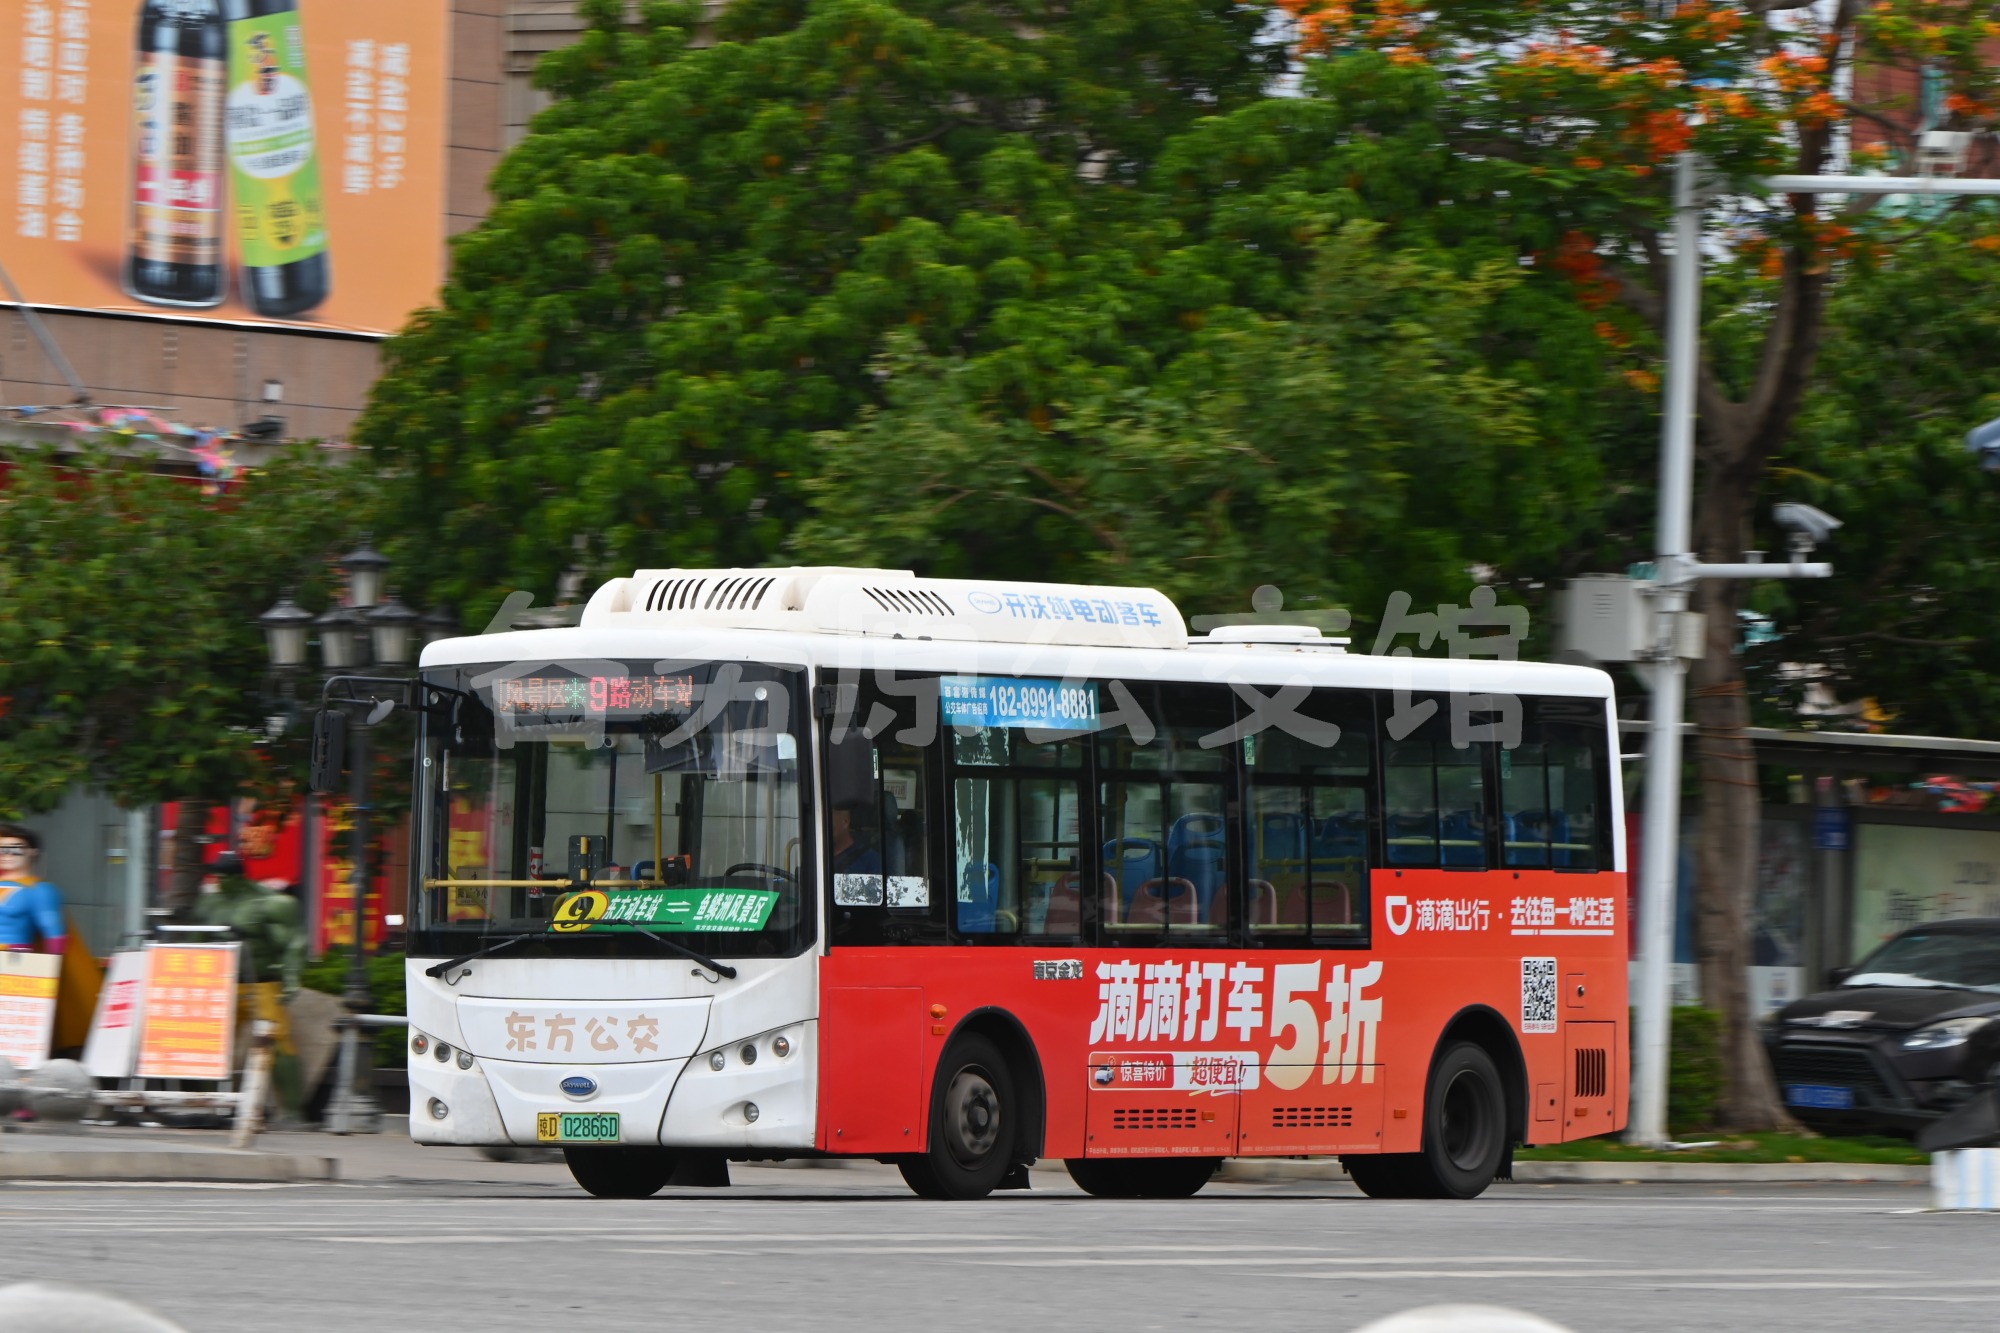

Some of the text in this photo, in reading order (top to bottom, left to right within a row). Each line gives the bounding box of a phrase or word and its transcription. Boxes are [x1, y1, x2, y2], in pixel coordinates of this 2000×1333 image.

[1002, 592, 1161, 627] 开沃纯电动客车
[990, 685, 1095, 720] 182-8991-8881
[560, 893, 768, 928] 9 东方动车站 鱼鳞洲风景区
[1416, 896, 1615, 932] 滴滴出行 去往每一种生活
[1033, 960, 1083, 980] 南京金龙
[505, 1011, 659, 1054] 东方公交
[1120, 1060, 1167, 1082] 惊喜特价
